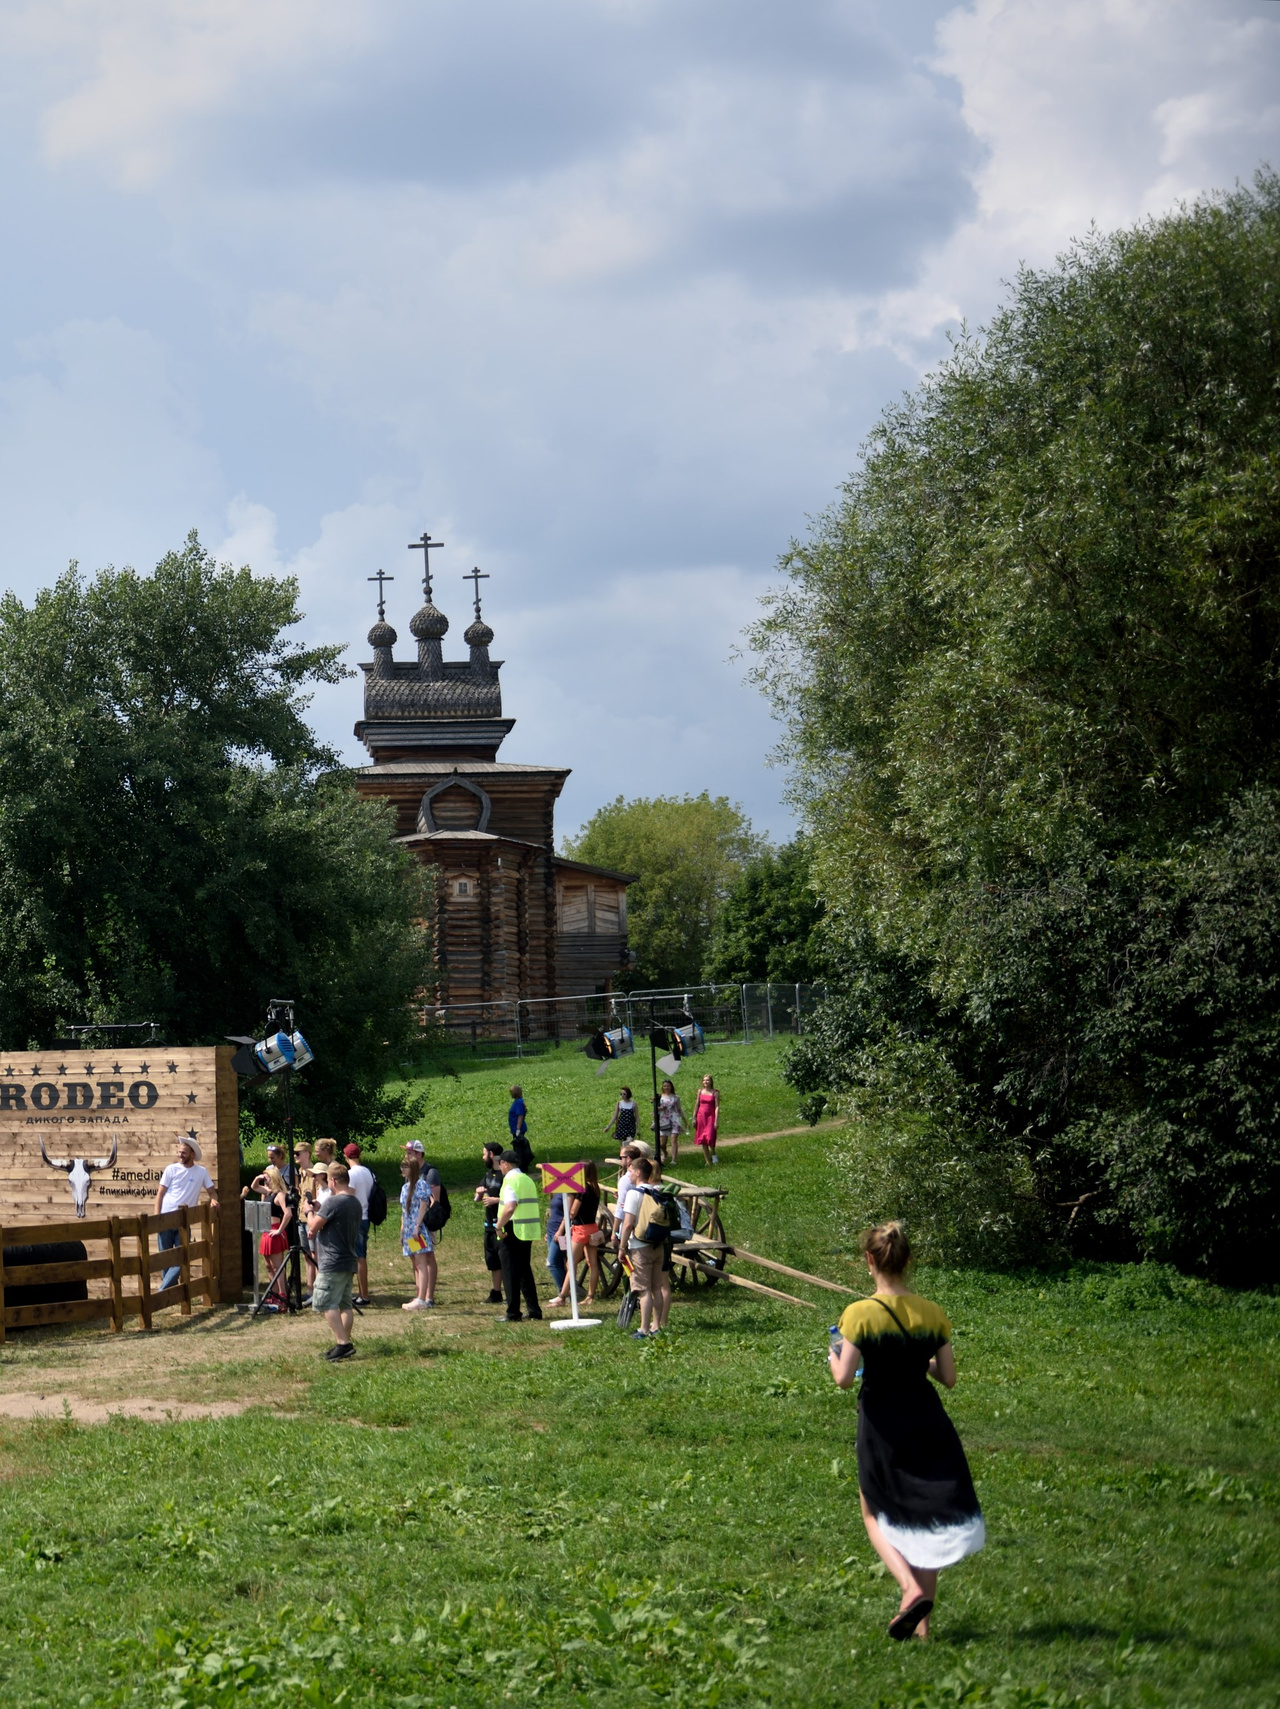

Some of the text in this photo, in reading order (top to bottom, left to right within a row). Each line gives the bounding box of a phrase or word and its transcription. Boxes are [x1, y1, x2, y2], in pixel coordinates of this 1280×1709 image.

[26, 1115, 129, 1125] ДИКОГО ЗАПАДА
[112, 1168, 164, 1181] #amediat
[99, 1185, 158, 1198] #пикникафиш
